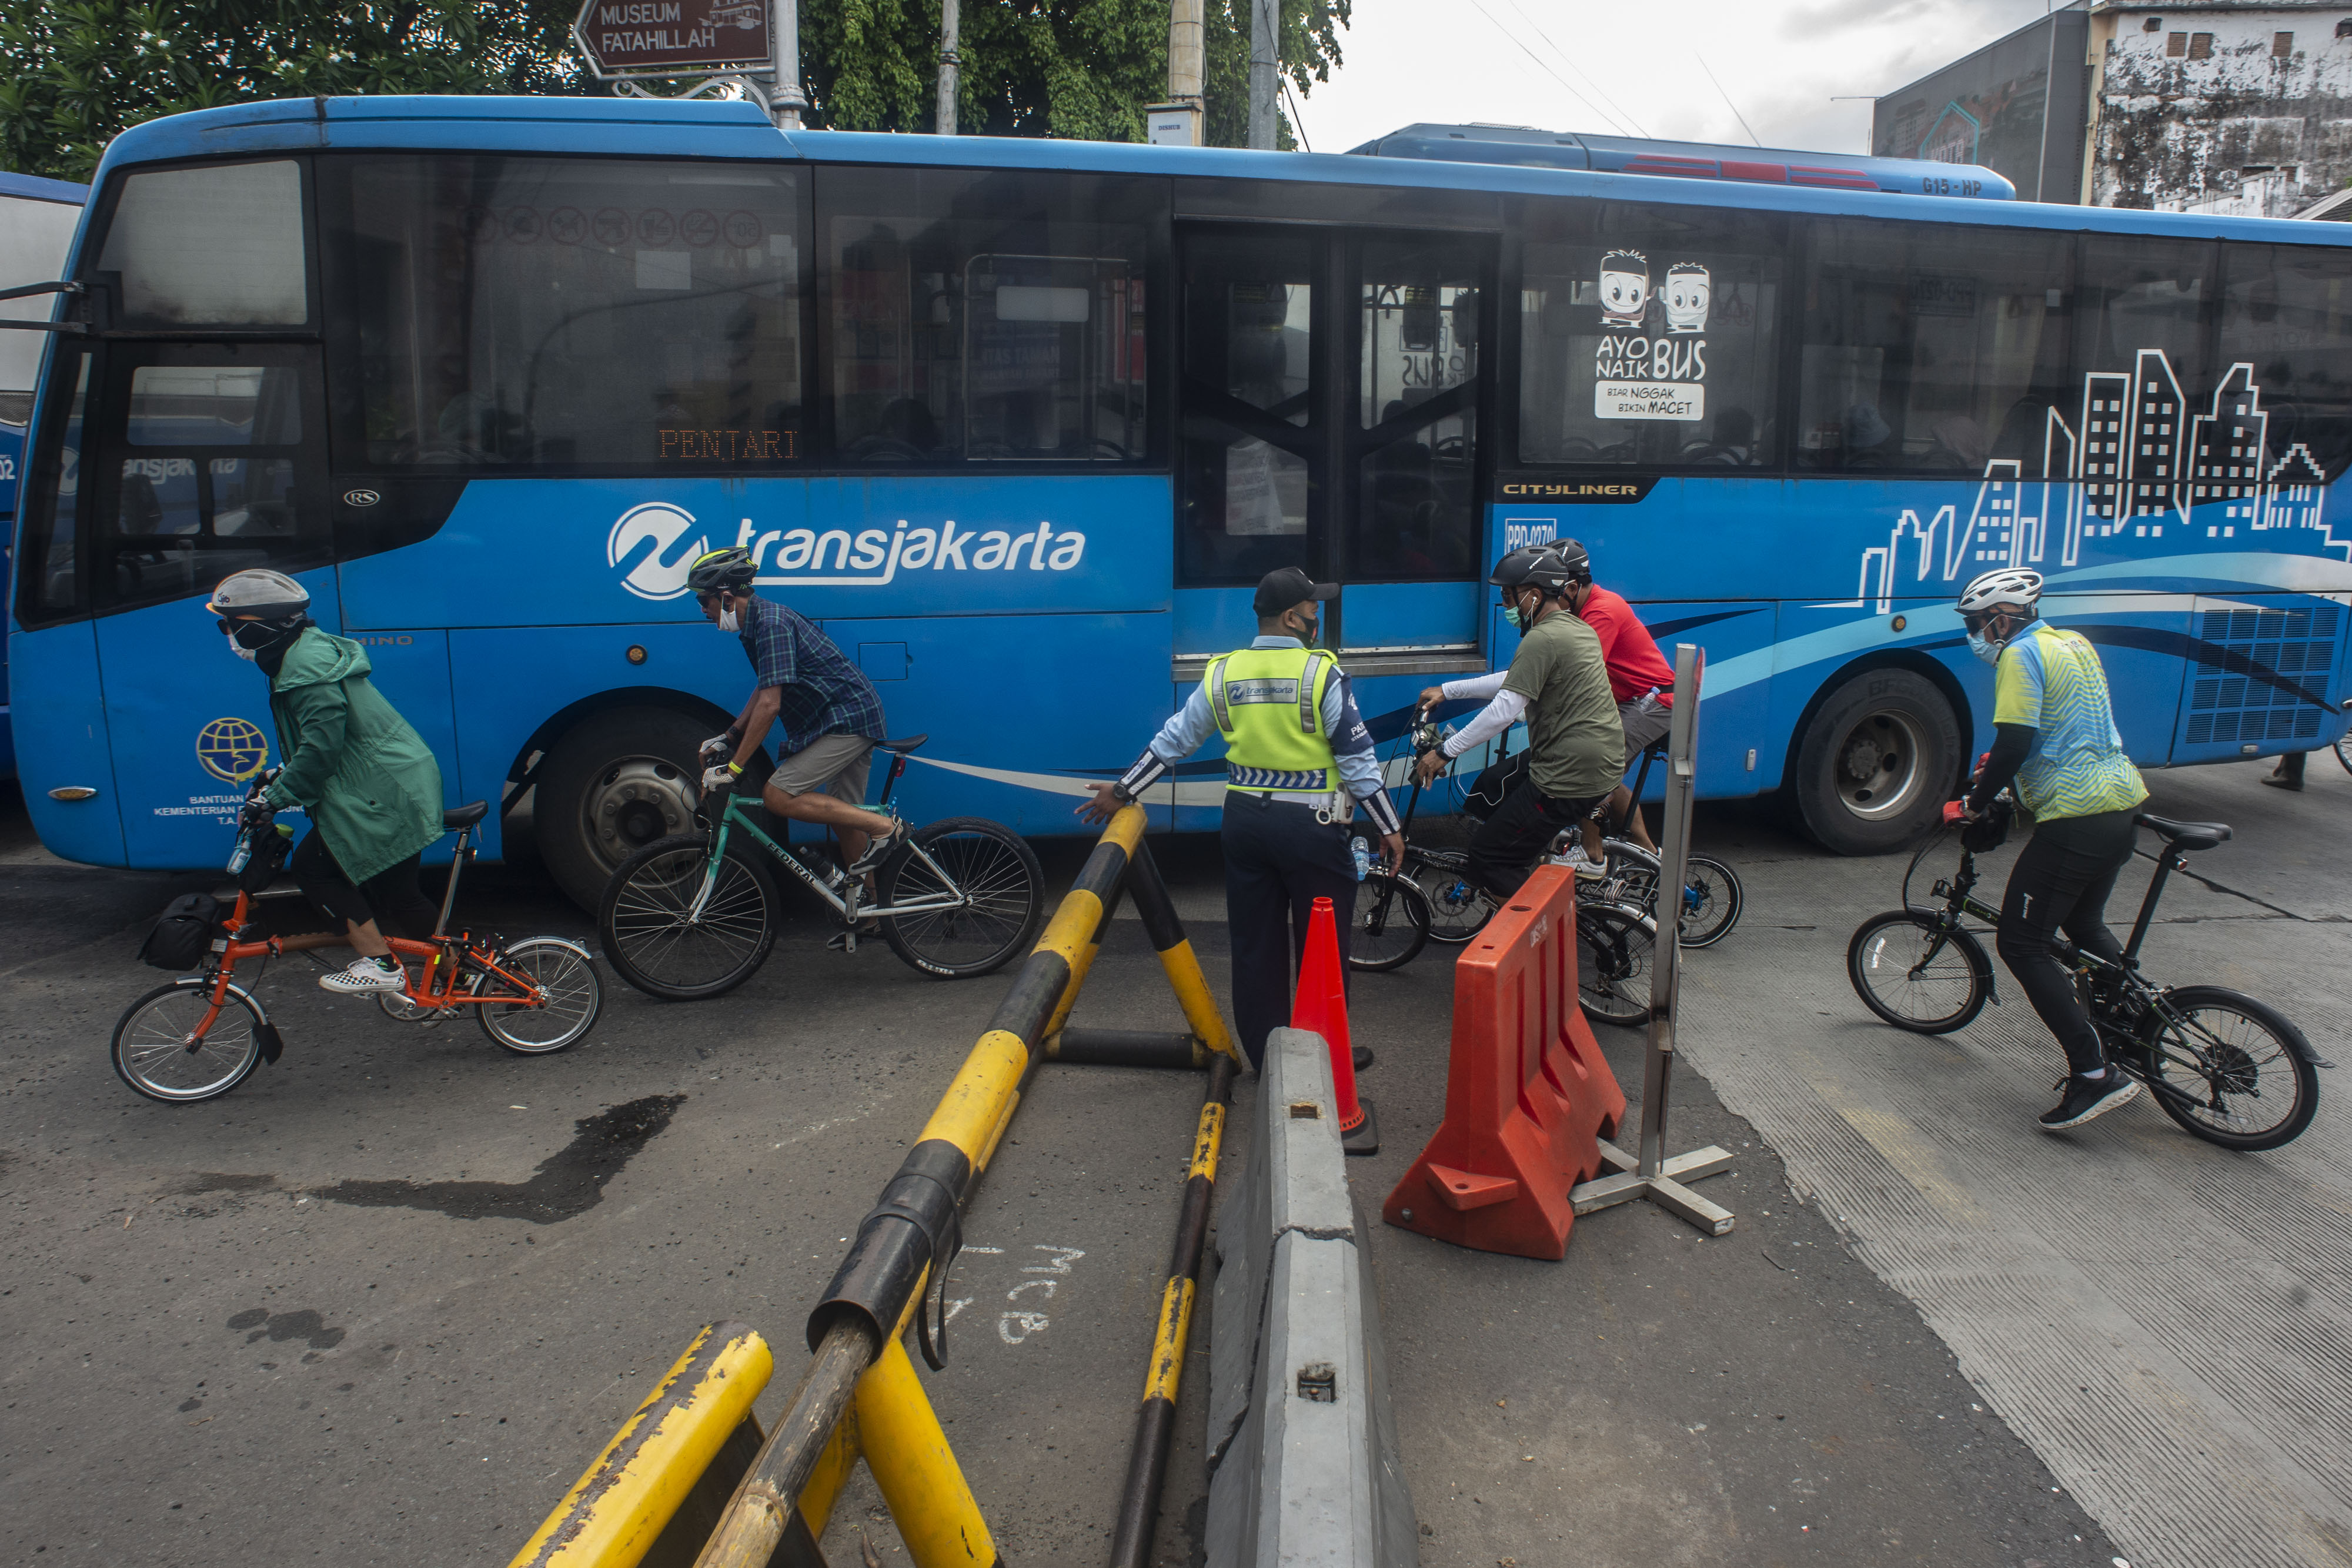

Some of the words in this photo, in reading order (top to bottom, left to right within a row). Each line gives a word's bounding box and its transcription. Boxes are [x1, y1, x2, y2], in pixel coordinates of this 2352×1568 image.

[600, 2, 681, 25] MUSEUM
[602, 28, 716, 52] FATAHILLAH
[1923, 177, 1949, 195] G15
[1962, 179, 1982, 197] HP
[1596, 335, 1649, 360] AYO
[1596, 359, 1649, 379] NAIK
[1653, 339, 1706, 380] BUS
[1607, 388, 1628, 396] BIAR
[1631, 387, 1675, 399] NGGAK
[1618, 403, 1646, 413] BIKIN
[1647, 401, 1692, 415] MACET
[349, 491, 375, 504] RS
[1502, 484, 1638, 496] CITYLINER
[1508, 525, 1553, 550] PPD-0270
[737, 518, 1086, 586] transjakarta
[352, 636, 413, 646] HINO
[189, 795, 244, 804] BANTUAN
[154, 806, 236, 816] KEMENTERIAN
[767, 841, 817, 886] FEDERAL
[998, 1244, 1087, 1345] MCB
